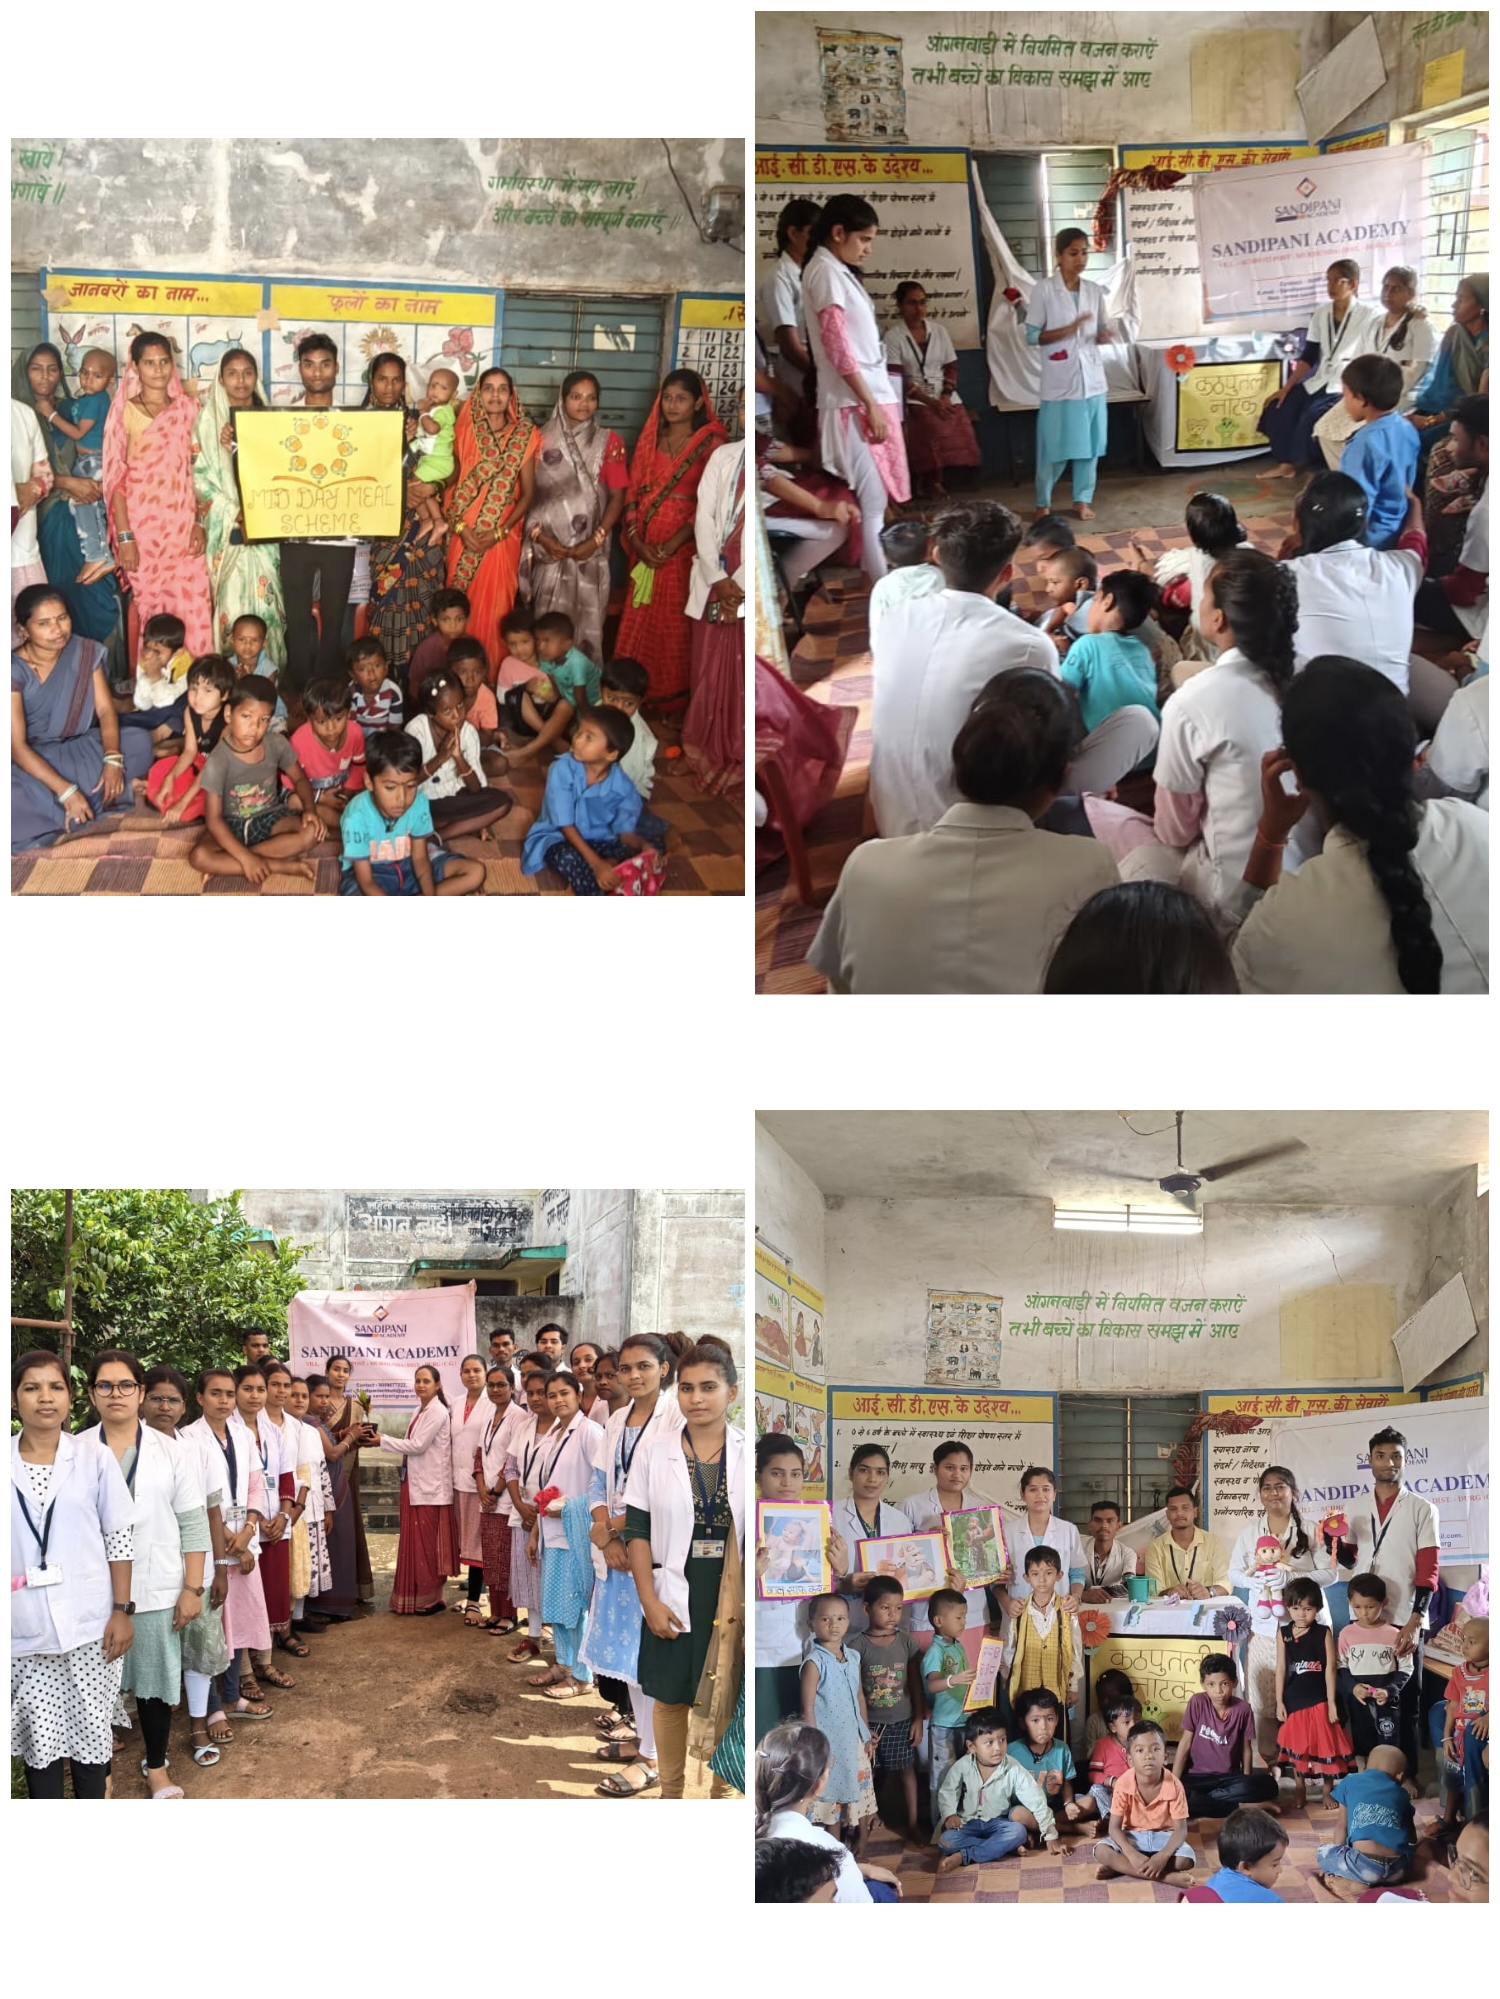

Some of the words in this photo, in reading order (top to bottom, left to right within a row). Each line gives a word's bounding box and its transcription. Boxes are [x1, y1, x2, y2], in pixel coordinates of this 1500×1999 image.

[1002, 32, 1019, 54] में
[1021, 34, 1076, 58] नियमित
[1081, 40, 1119, 58] वजन
[911, 61, 948, 86] तभी
[985, 68, 1006, 87] का
[1008, 63, 1053, 88] विकास
[1059, 70, 1100, 92] समझ
[1100, 65, 1120, 87] में
[1122, 70, 1152, 88] आए
[1274, 199, 1341, 216] SANDIPANI
[1212, 232, 1309, 258] SANDIPANI
[1315, 220, 1411, 246] ACADEMY
[68, 278, 130, 301] जानवरों
[135, 284, 159, 300] का
[375, 297, 400, 313] का
[705, 331, 716, 342] 11
[725, 331, 739, 343] 21
[682, 346, 690, 358] 2
[704, 346, 716, 359] 12
[723, 346, 740, 359] 22
[721, 363, 737, 377] 23
[720, 381, 737, 395] 24
[718, 399, 735, 414] 25
[247, 487, 290, 510] MID
[296, 486, 340, 510] DAY
[346, 484, 395, 509] MEAL
[281, 512, 362, 534] SCHEME
[1095, 1290, 1111, 1311] में
[1112, 1292, 1167, 1314] नियमित
[1170, 1298, 1208, 1313] वजन
[355, 1324, 407, 1334] SANDIPANI
[1008, 1316, 1042, 1338] तभी
[1077, 1323, 1096, 1339] का
[1098, 1318, 1142, 1339] विकास
[1147, 1323, 1189, 1343] समझ
[1189, 1318, 1207, 1339] में
[1209, 1323, 1240, 1340] आए
[301, 1346, 381, 1359] SANDIPANI
[385, 1345, 460, 1360] ACADEMY
[1403, 1473, 1489, 1494] ACADEM
